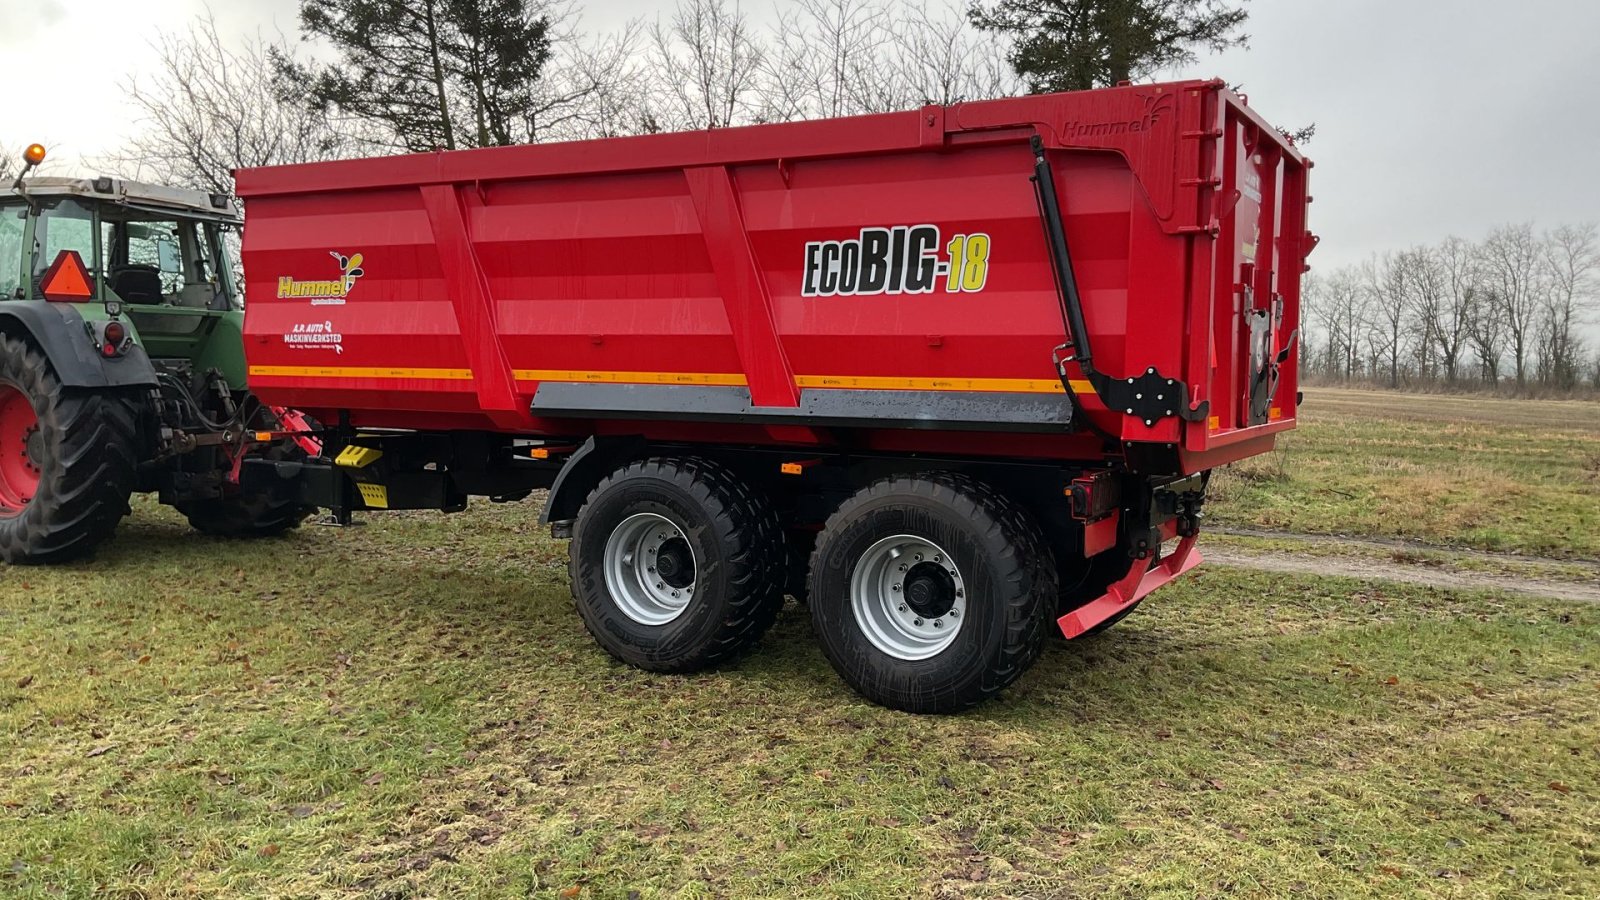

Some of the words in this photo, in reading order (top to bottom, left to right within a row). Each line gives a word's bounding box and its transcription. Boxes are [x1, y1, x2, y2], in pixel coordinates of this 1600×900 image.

[1062, 114, 1150, 139] Hummel
[278, 276, 347, 298] Hummel
[306, 323, 324, 333] AUTO
[284, 333, 342, 343] MASKINVÆRKSTED
